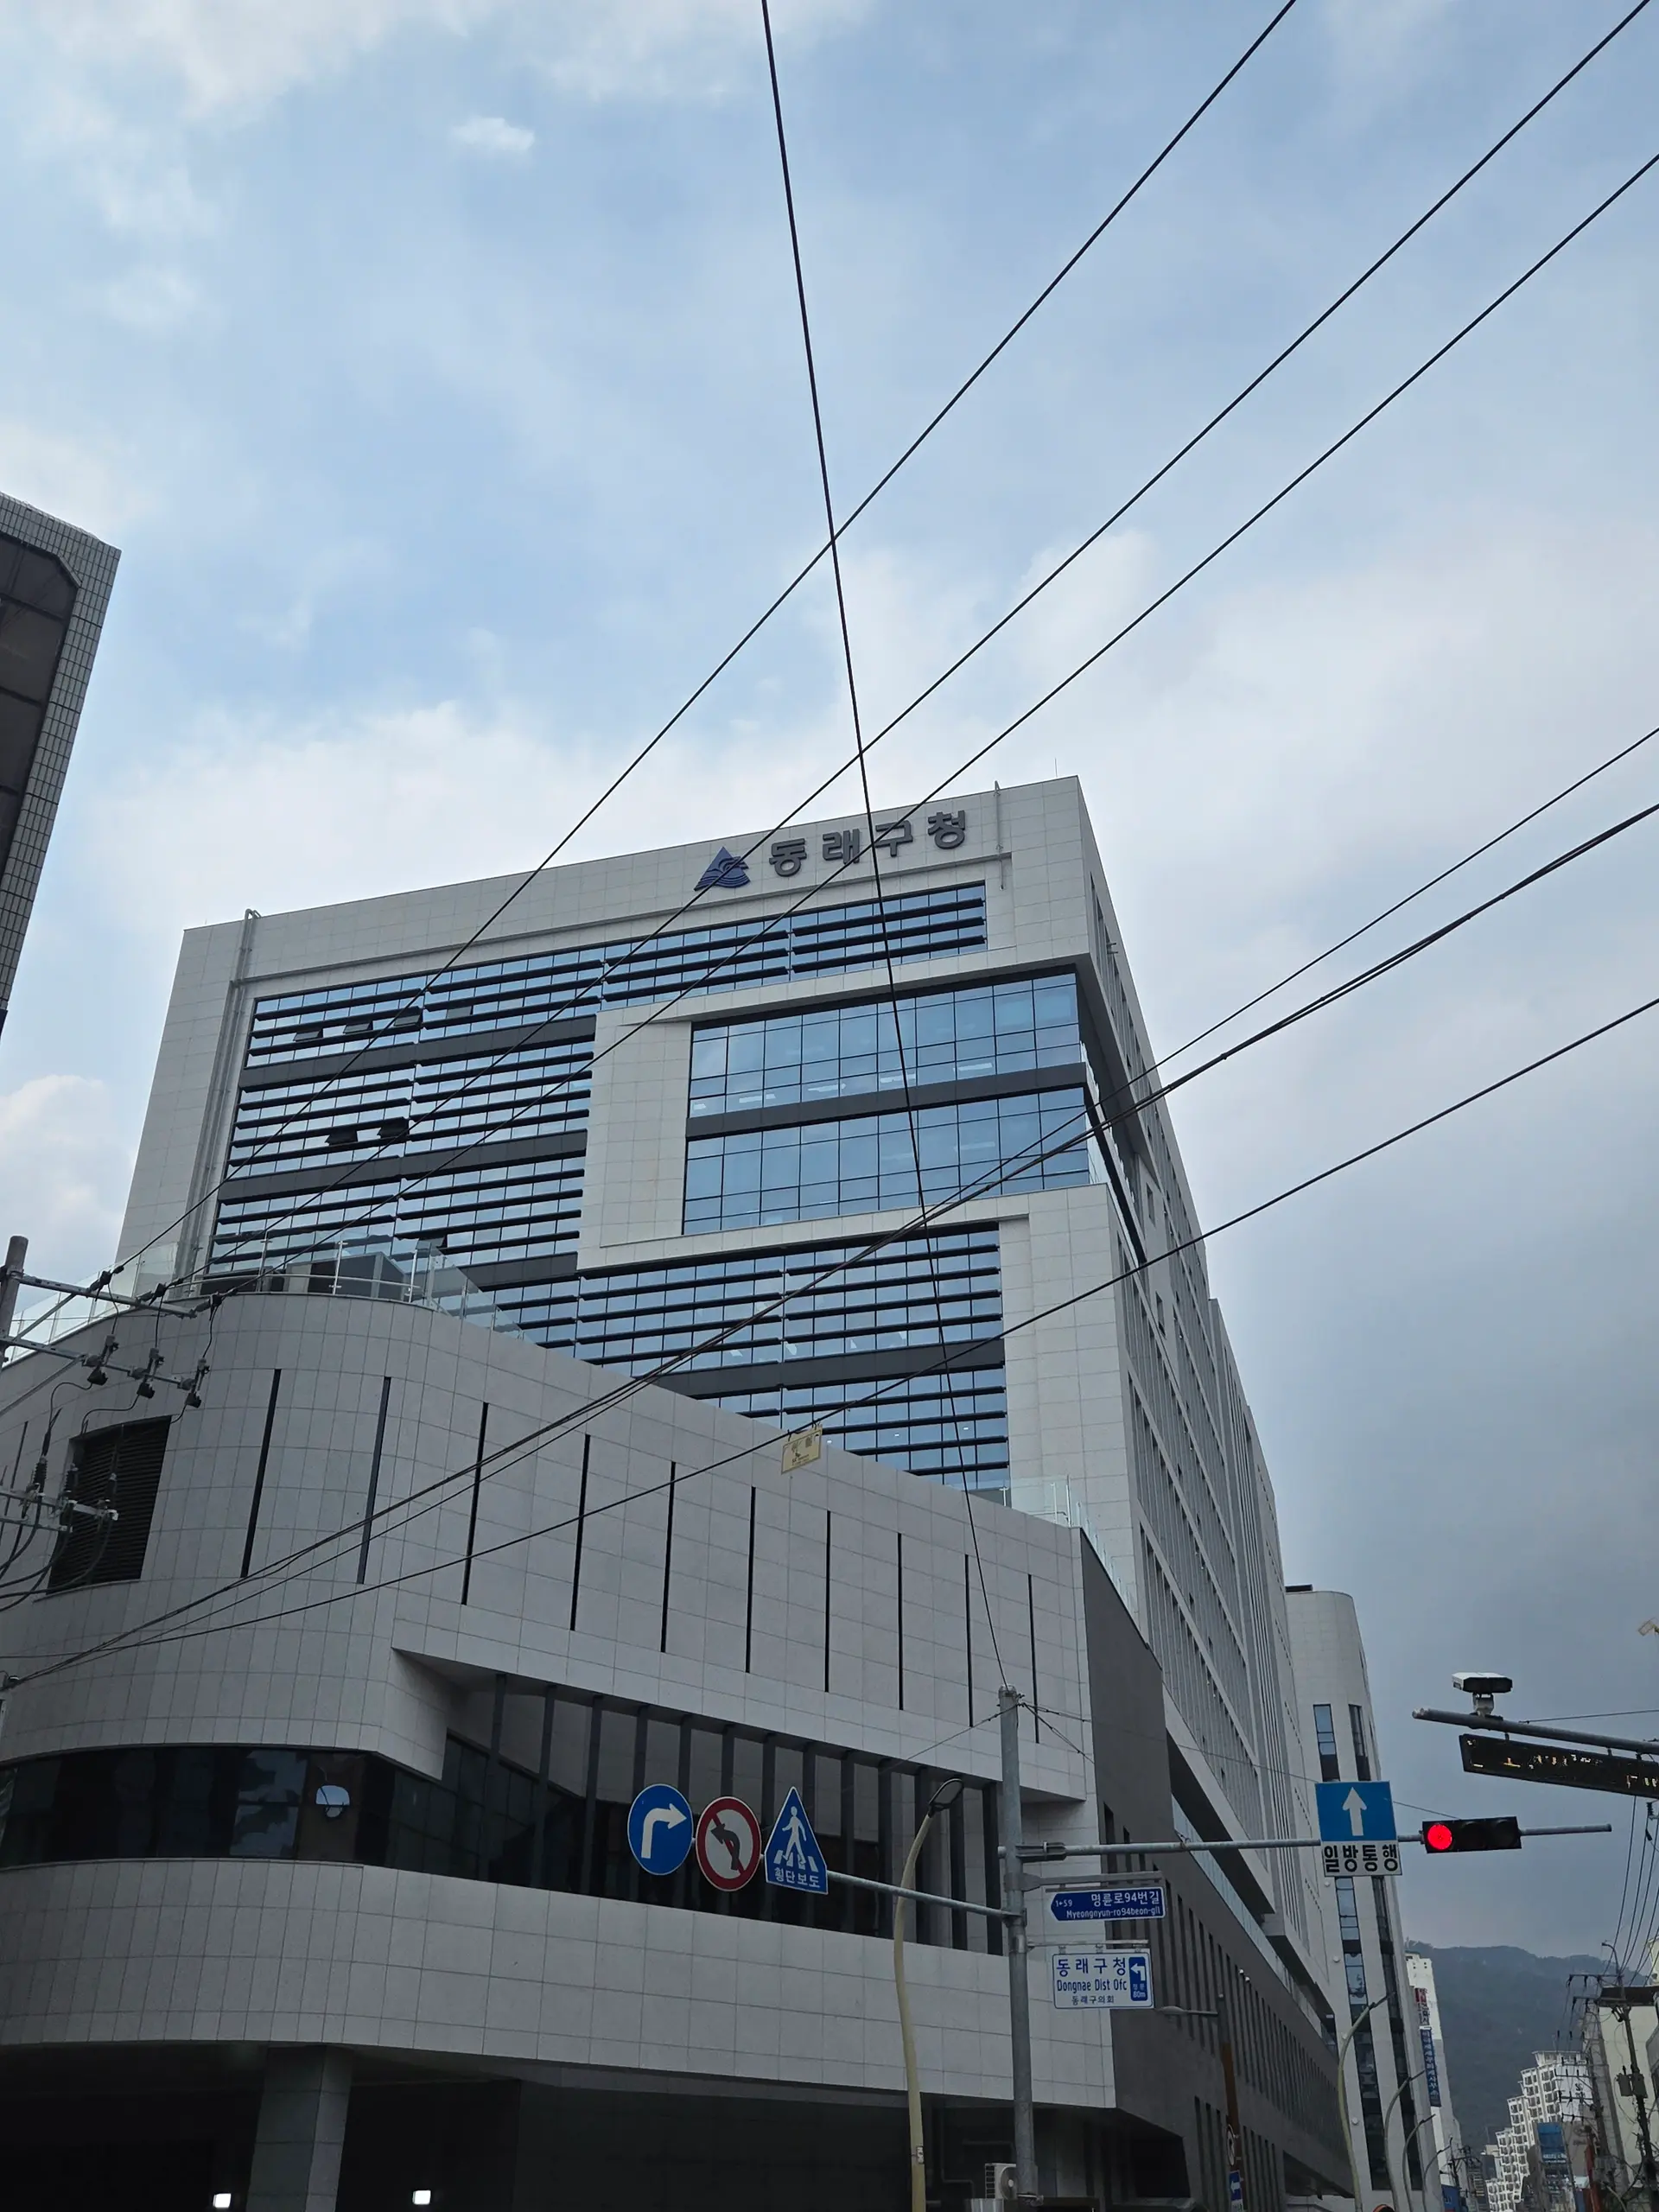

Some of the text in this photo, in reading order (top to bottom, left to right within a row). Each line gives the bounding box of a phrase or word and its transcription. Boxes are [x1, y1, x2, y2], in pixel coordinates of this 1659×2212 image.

[769, 810, 966, 877] 동래구청
[1324, 1844, 1398, 1872] 일방통행
[774, 1867, 820, 1888] 횡단보도
[1091, 1891, 1160, 1906] 명륜로94번길
[1056, 1957, 1126, 1976] 동래구청
[1057, 1979, 1128, 1993] Dongnae Dist Ofc
[1071, 1995, 1115, 2005] 동래구의회
